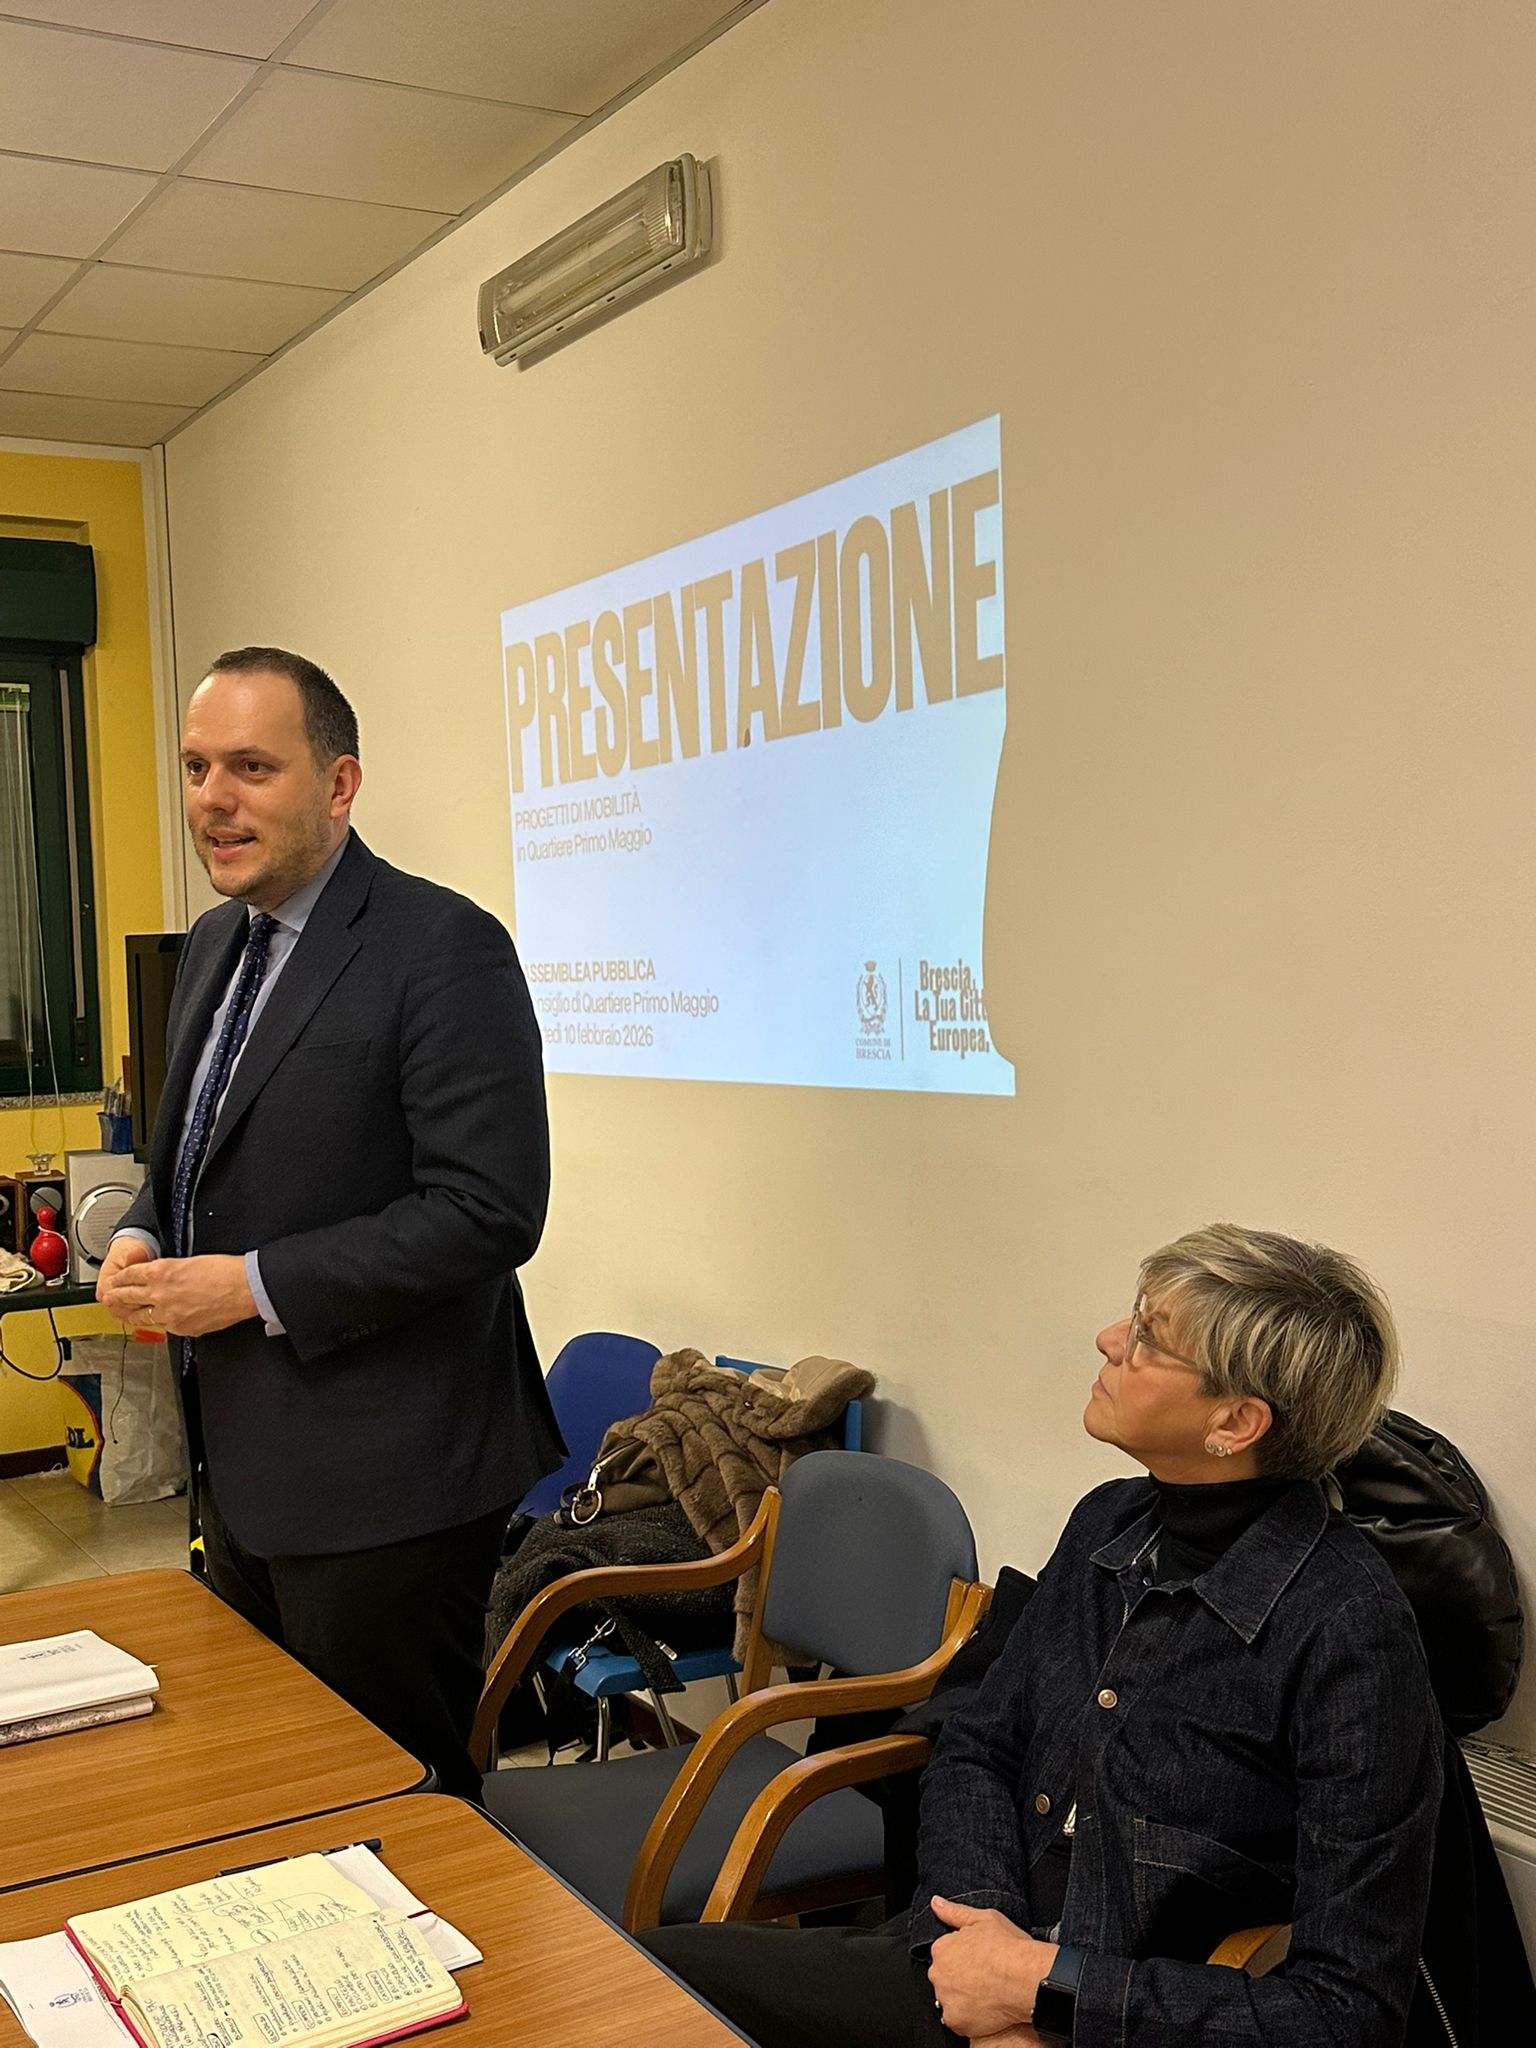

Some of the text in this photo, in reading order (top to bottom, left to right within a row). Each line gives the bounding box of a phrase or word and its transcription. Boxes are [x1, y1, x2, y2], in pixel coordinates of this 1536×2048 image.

[505, 468, 1004, 793] PRESENTAZIONE
[515, 784, 642, 831] PROGETTI DI MOBILITÀ
[515, 822, 652, 862] in Quartiere Primo Maggio
[592, 957, 657, 982] PUBBLICA
[571, 988, 582, 1013] di
[582, 991, 632, 1013] Quartiere
[633, 990, 669, 1014] Primo
[671, 988, 719, 1018] Maggio
[914, 987, 988, 1021] La Tua Citt
[563, 1023, 576, 1045] 10
[577, 1023, 621, 1046] febbraio
[623, 1024, 654, 1047] 2026
[856, 1048, 891, 1060] BRESCIA
